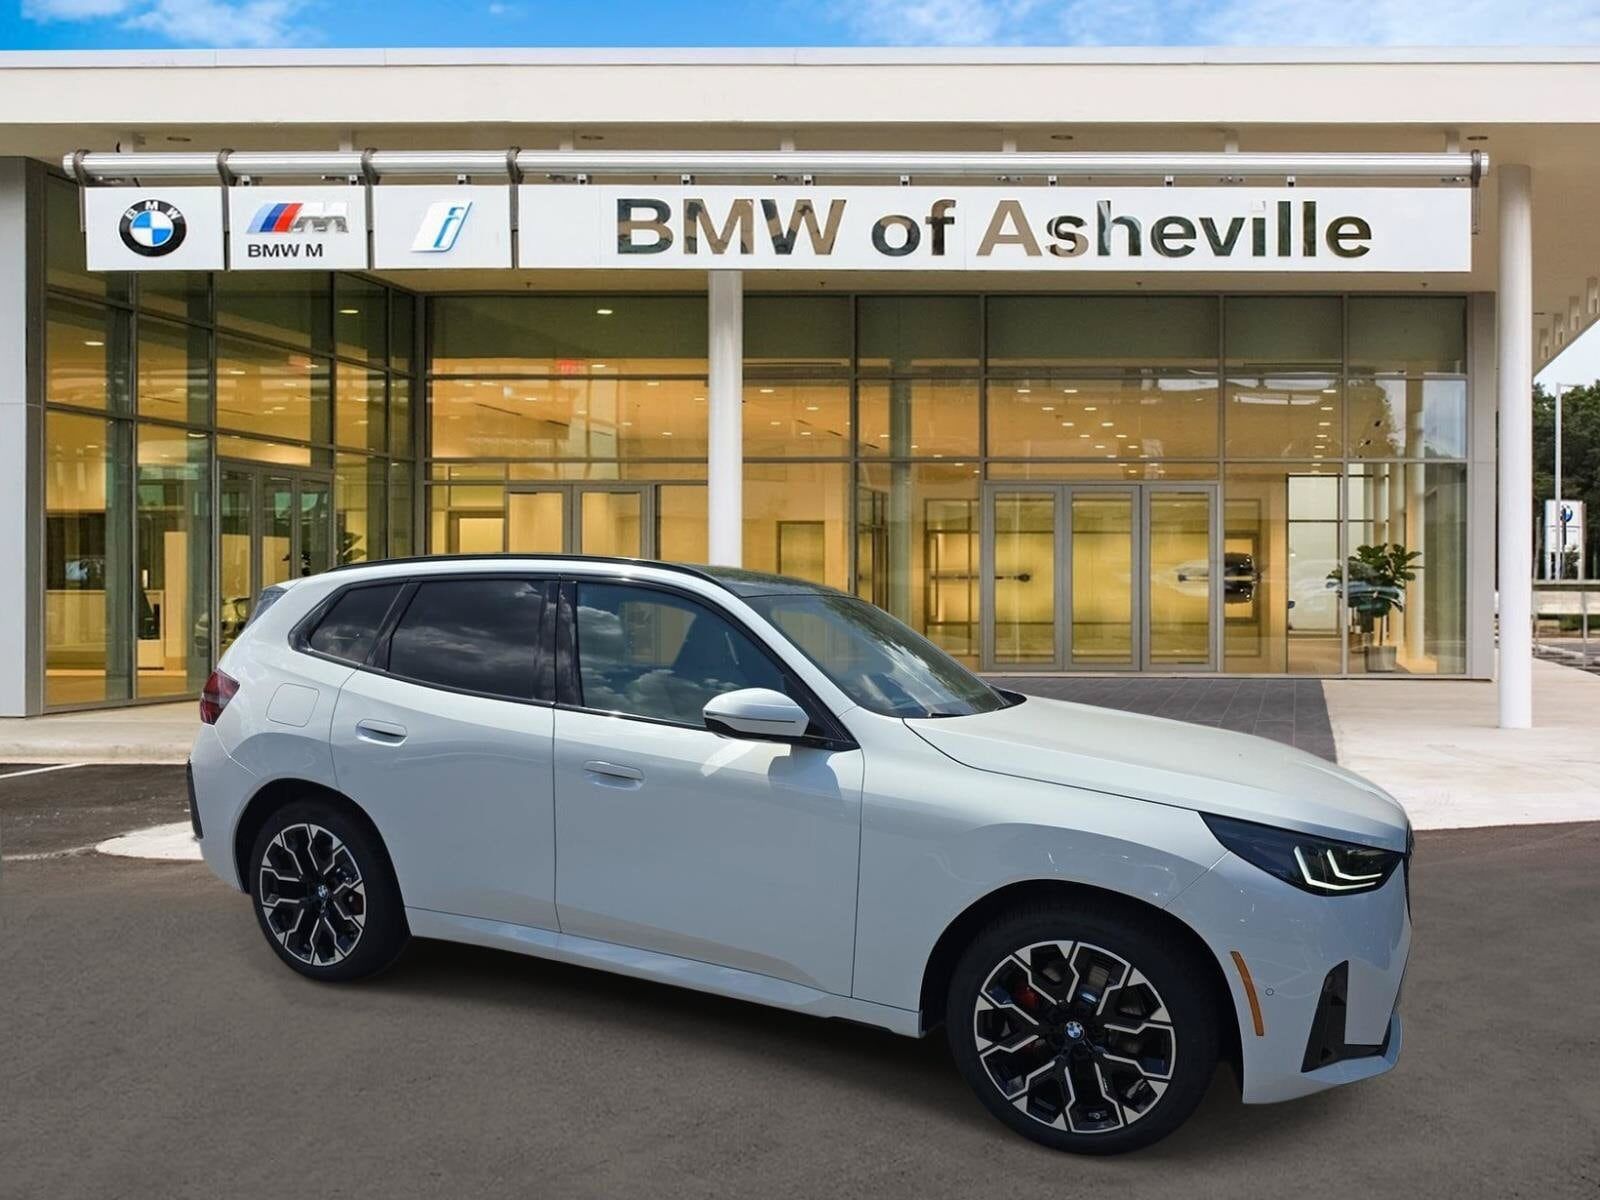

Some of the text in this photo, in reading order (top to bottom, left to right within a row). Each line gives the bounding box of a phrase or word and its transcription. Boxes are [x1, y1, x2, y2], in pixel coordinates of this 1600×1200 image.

[616, 198, 1372, 258] BMW of Asheville
[247, 243, 323, 258] BMW M
